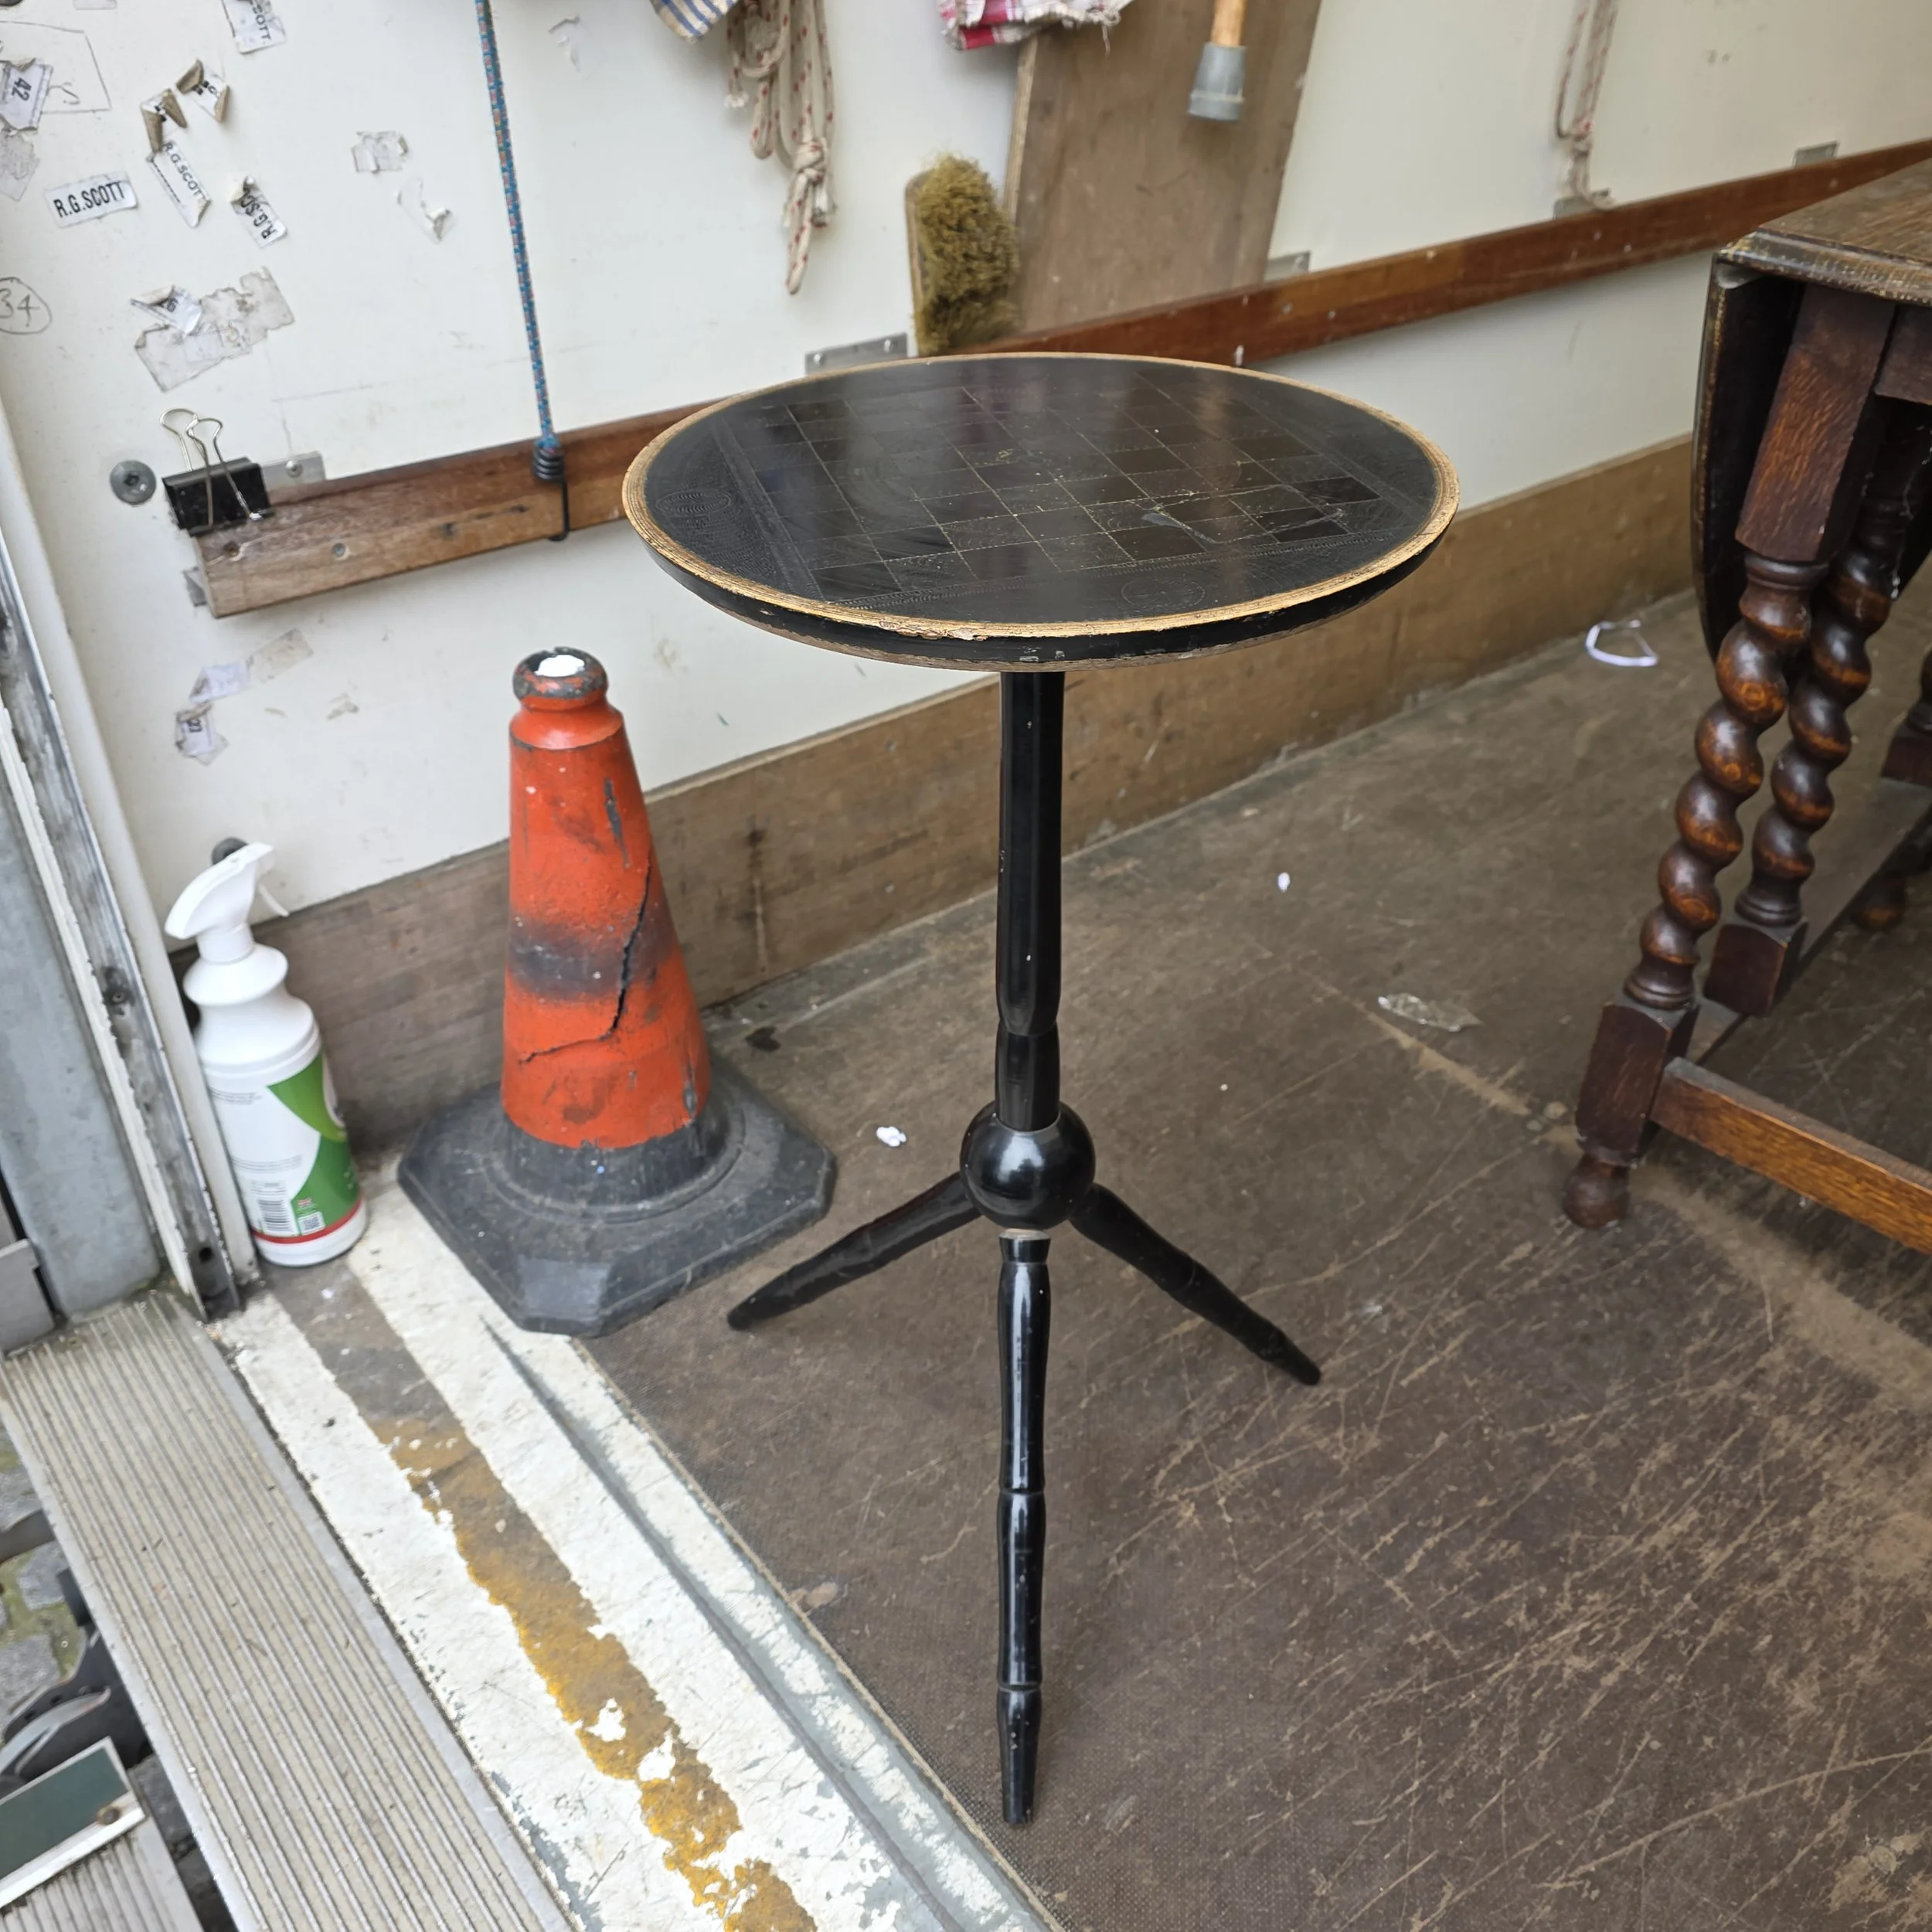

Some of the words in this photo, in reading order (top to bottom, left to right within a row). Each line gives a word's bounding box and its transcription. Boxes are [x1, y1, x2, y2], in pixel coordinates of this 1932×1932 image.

[12, 77, 32, 101] 42
[53, 180, 125, 218] R.G.SCOTT
[241, 187, 276, 239] R.G.SC
